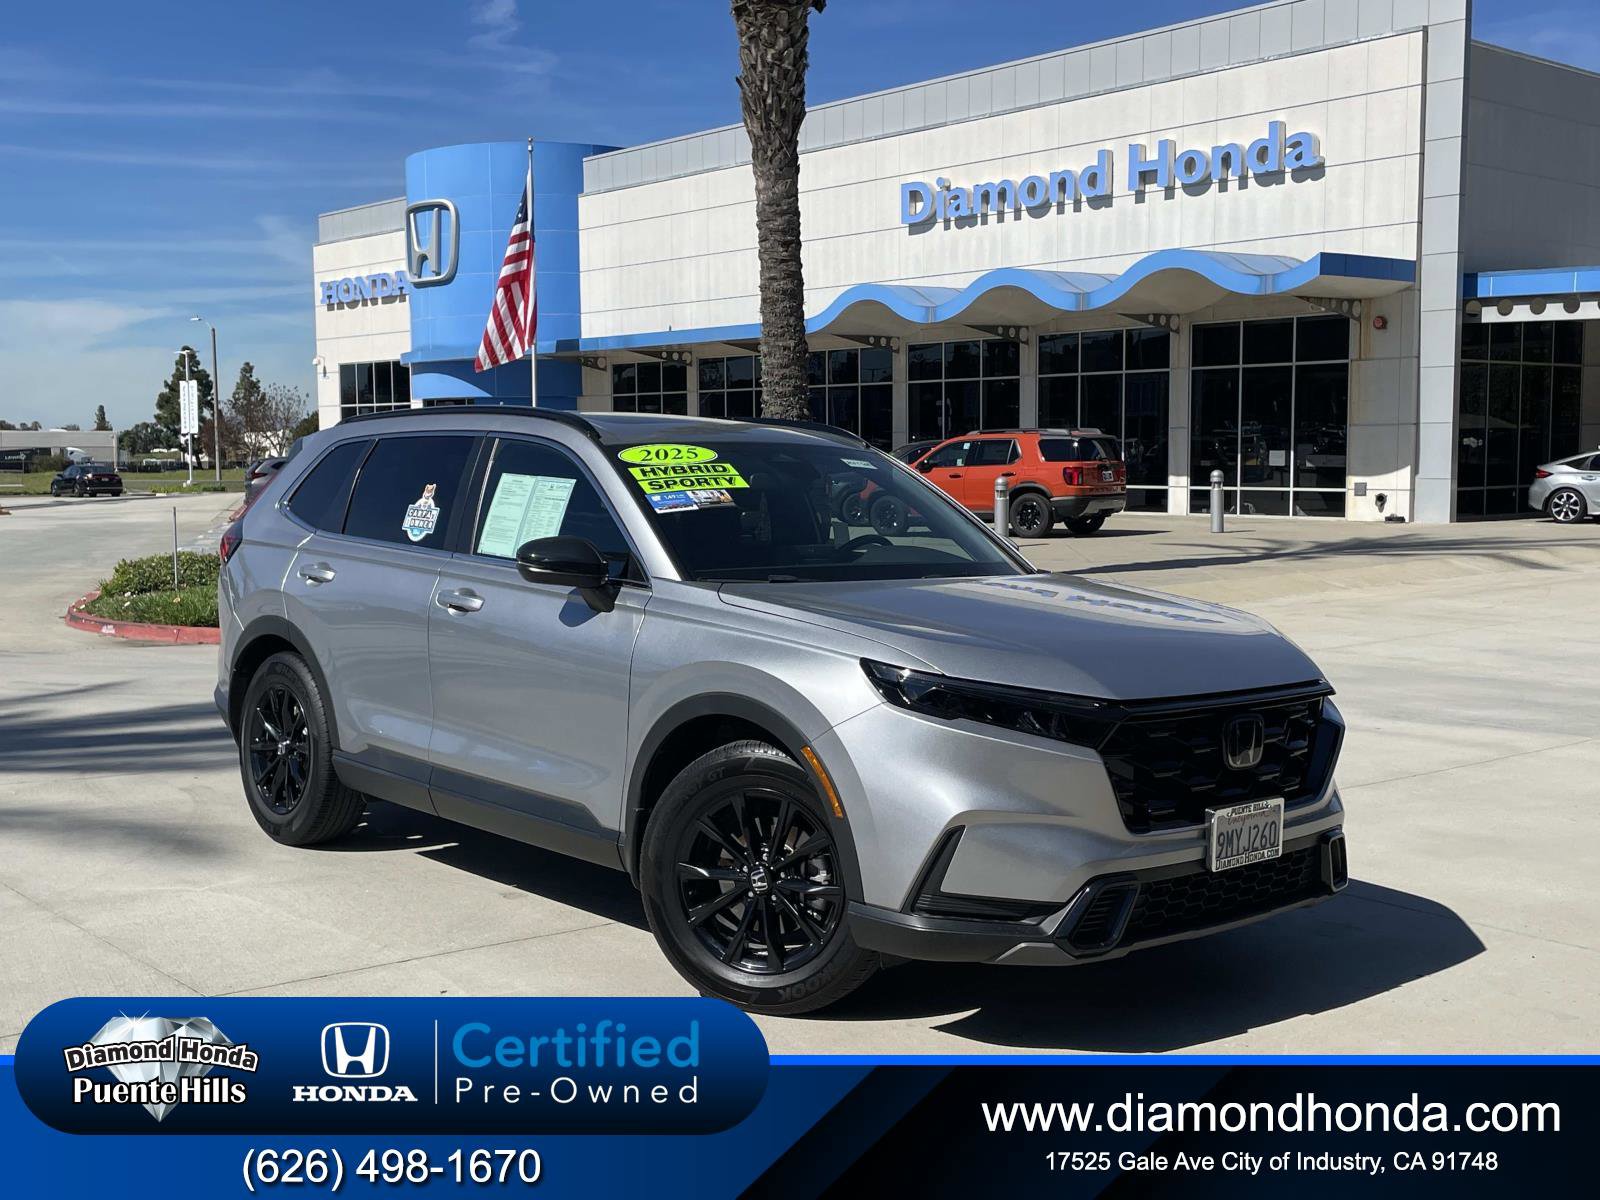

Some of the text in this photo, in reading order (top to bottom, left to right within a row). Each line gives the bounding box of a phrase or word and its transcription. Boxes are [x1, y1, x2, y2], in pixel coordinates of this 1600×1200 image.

[901, 120, 1322, 225] Diamond Honda
[320, 271, 409, 304] HONDA
[641, 447, 699, 462] 2025
[641, 464, 730, 478] HYBRID
[647, 476, 735, 491] SPORTY
[1216, 820, 1277, 860] 9MYJ260
